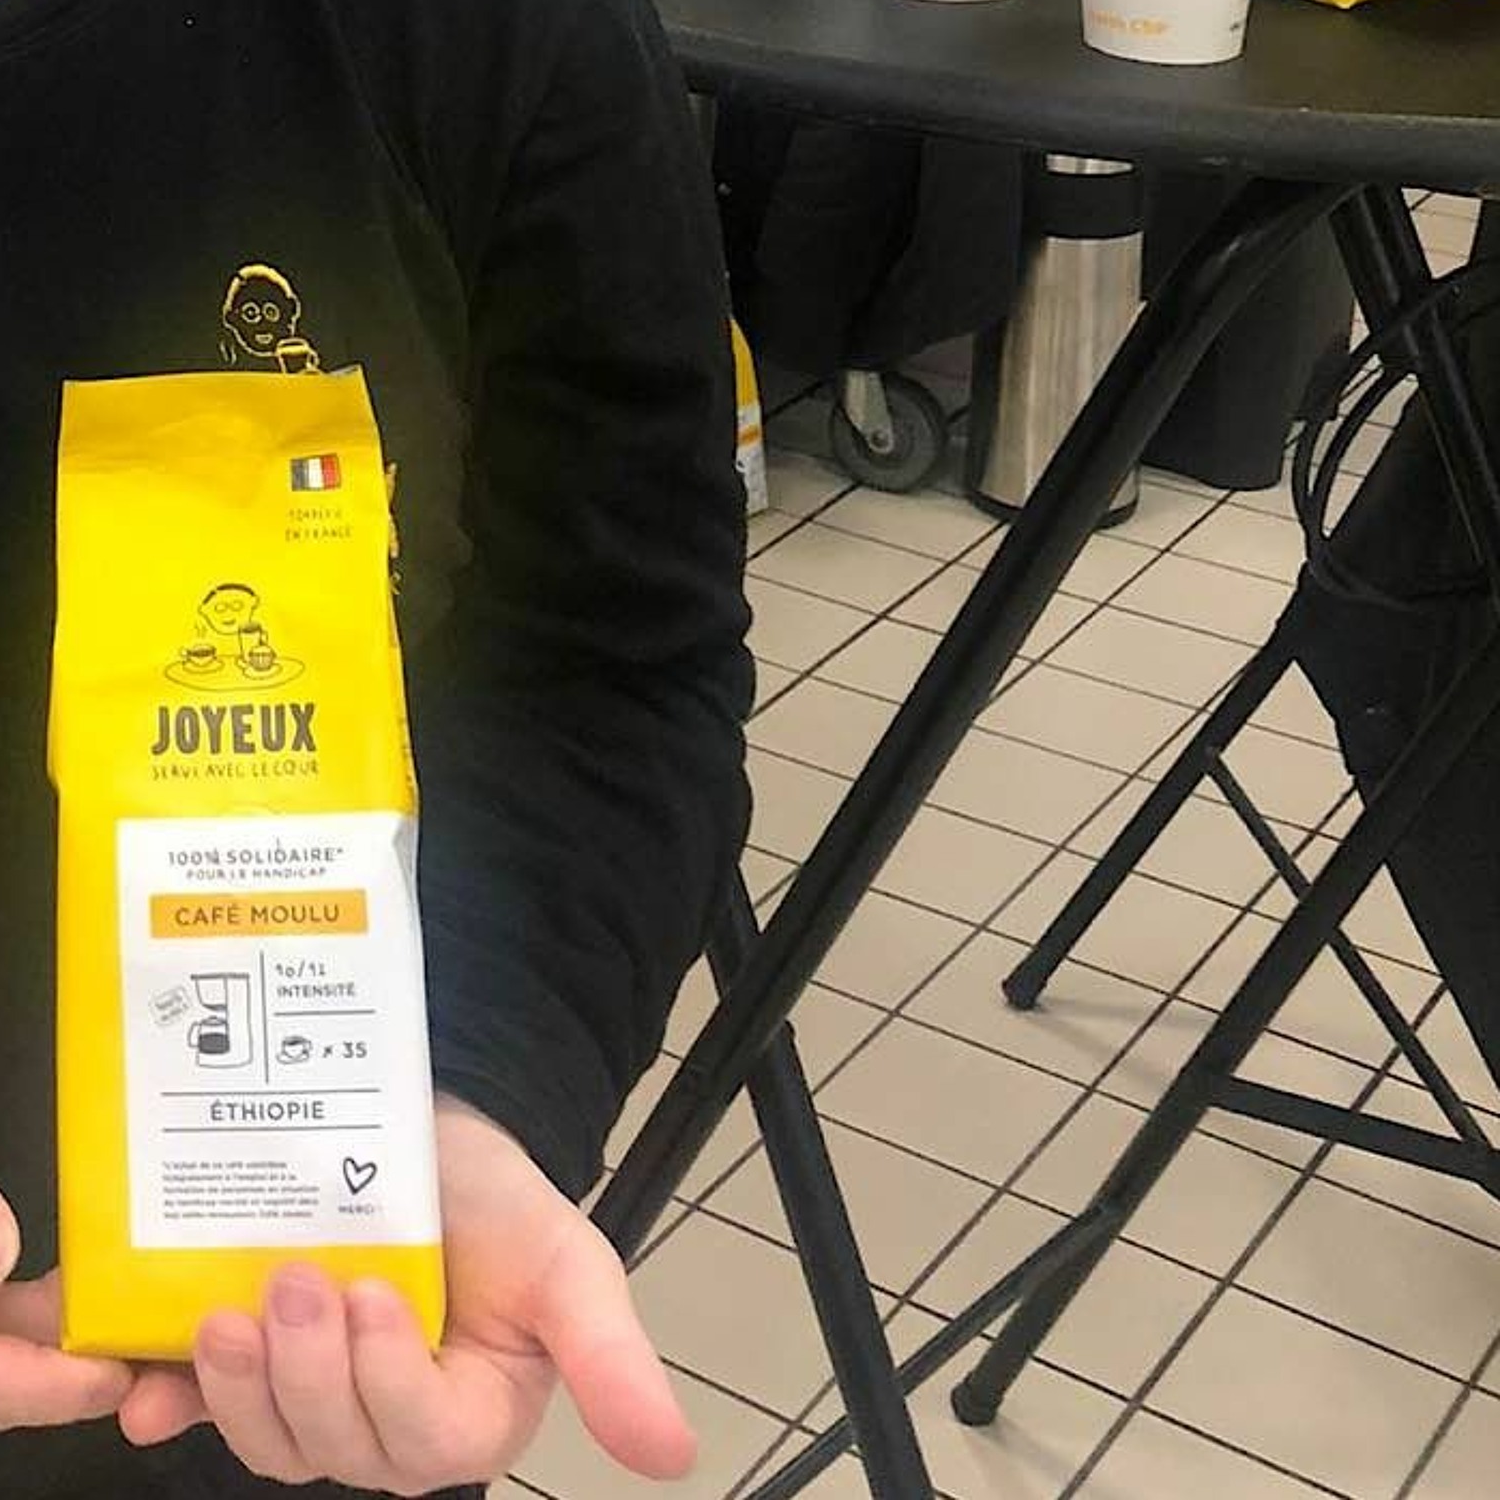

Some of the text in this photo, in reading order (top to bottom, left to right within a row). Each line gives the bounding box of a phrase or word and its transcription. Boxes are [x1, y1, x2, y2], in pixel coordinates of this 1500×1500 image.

[151, 702, 317, 756] JOYEUX
[206, 763, 244, 778] AVEC
[252, 761, 268, 777] LE
[168, 850, 220, 866] 100%
[253, 867, 326, 879] HANDICAP
[175, 904, 339, 926] CAFÉ MOULU
[342, 1041, 368, 1058] 35
[210, 1099, 325, 1121] ÉTHIOPIE
